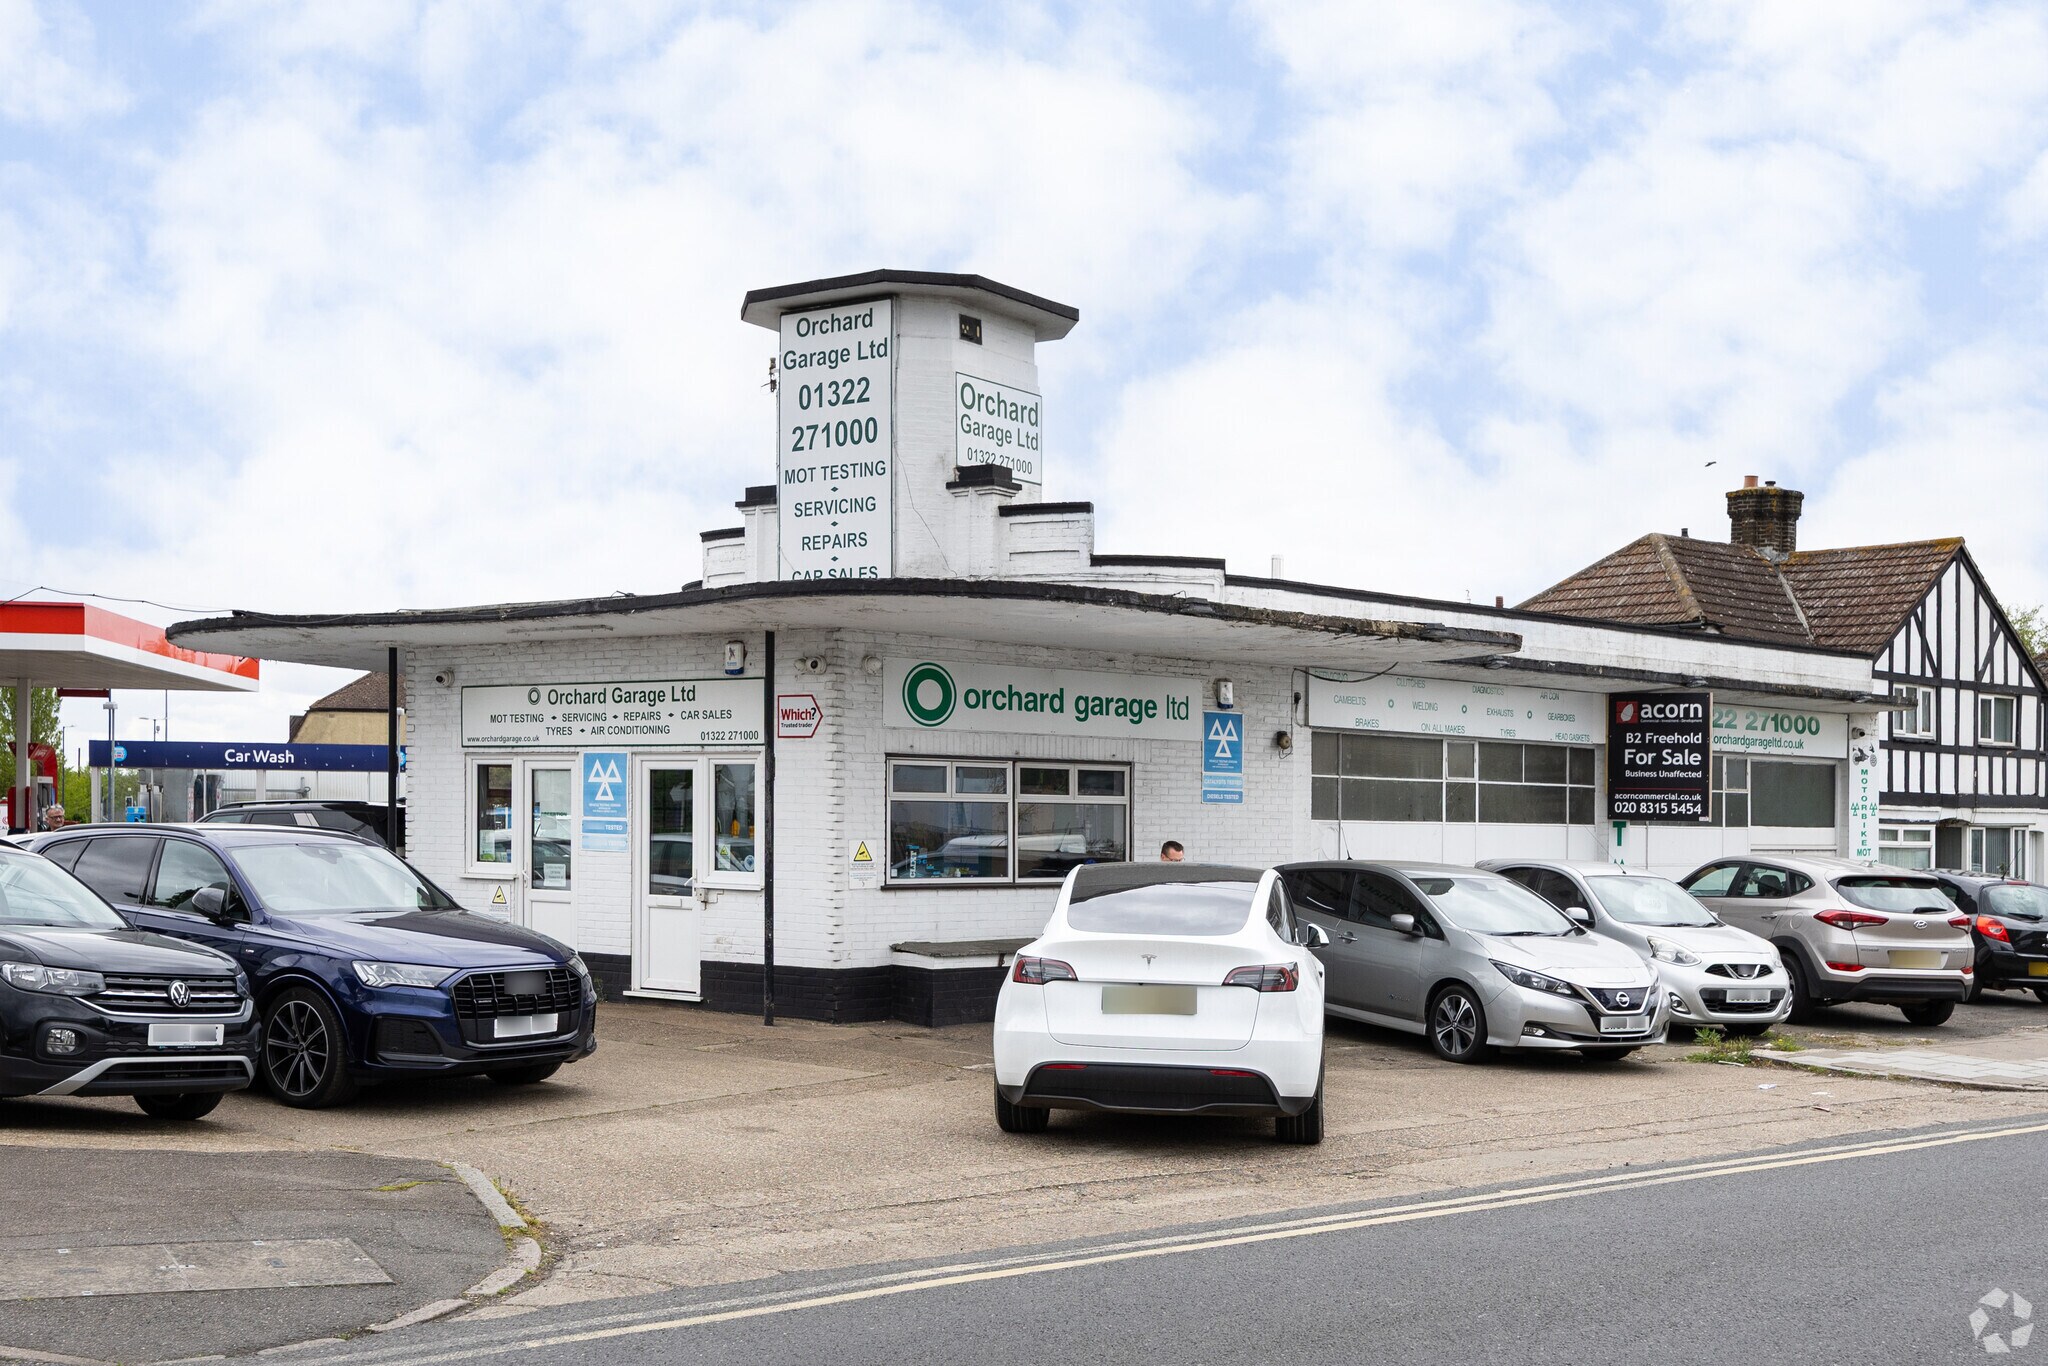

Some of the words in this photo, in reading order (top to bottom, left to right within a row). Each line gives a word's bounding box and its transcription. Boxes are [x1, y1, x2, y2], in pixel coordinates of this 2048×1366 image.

[796, 308, 873, 337] Orchard
[783, 347, 850, 370] Garage
[857, 337, 888, 361] Ltd
[798, 376, 870, 410] 01322
[960, 382, 1038, 428] Orchard
[791, 416, 878, 452] 271000
[960, 413, 1012, 447] Garage
[1017, 427, 1038, 451] Ltd
[967, 447, 996, 465] 01322
[999, 454, 1033, 475] 271000
[784, 467, 816, 485] MOT
[821, 460, 886, 481] TESTING
[794, 496, 876, 518] SERVICING
[802, 531, 868, 551] REPAIRS
[1396, 677, 1426, 689] CLUTCHES
[547, 687, 607, 706] Orchard
[611, 686, 666, 707] Garage
[671, 685, 696, 702] Ltd
[1472, 685, 1505, 696] DIAGNOSTICS
[963, 684, 1065, 714] orchard
[1074, 693, 1158, 725] garage
[1166, 694, 1189, 721] ltd
[1333, 694, 1367, 706] CAMBELTS
[1412, 701, 1439, 712] WELDING
[490, 714, 508, 723] MOT
[510, 713, 544, 723] TESTING
[561, 712, 607, 723] SERVICING
[623, 711, 661, 721] REPAIRS
[680, 710, 700, 720] CAR
[702, 709, 732, 720] SALES
[780, 706, 817, 720] Which?
[1486, 707, 1514, 718] EXHAUSTS
[1547, 712, 1576, 722] GEARBOXES
[1640, 703, 1703, 719] acorn
[545, 726, 573, 736] TYRES
[590, 726, 606, 735] AIR
[607, 724, 671, 735] CONDITIONING
[1355, 718, 1380, 728] BRAKES
[1421, 723, 1431, 731] ON
[1432, 723, 1443, 733] ALL
[1444, 725, 1466, 734] MAKES
[1745, 710, 1821, 736] 271000
[466, 735, 540, 744] www.orchardgarage.co.uk
[700, 731, 726, 741] 01322
[728, 730, 759, 741] 271000
[1500, 728, 1517, 738] TYRES
[1555, 732, 1569, 741] HEAD
[1568, 732, 1591, 743] GASKETS
[1626, 732, 1642, 744] B2
[1645, 732, 1702, 744] Freehold
[224, 749, 251, 763] Car
[252, 749, 295, 764] Wash
[1624, 748, 1657, 765] For
[1661, 748, 1702, 766] Sale
[1625, 769, 1657, 778] Business
[1659, 770, 1702, 778] Unaffected
[1614, 792, 1702, 801] acorncommercial.co.uk
[1614, 801, 1637, 814] 020
[1639, 801, 1668, 814] 8315
[1671, 802, 1702, 815] 5454
[1860, 768, 1869, 847] MOTORBIKE
[1856, 848, 1872, 857] MOT
